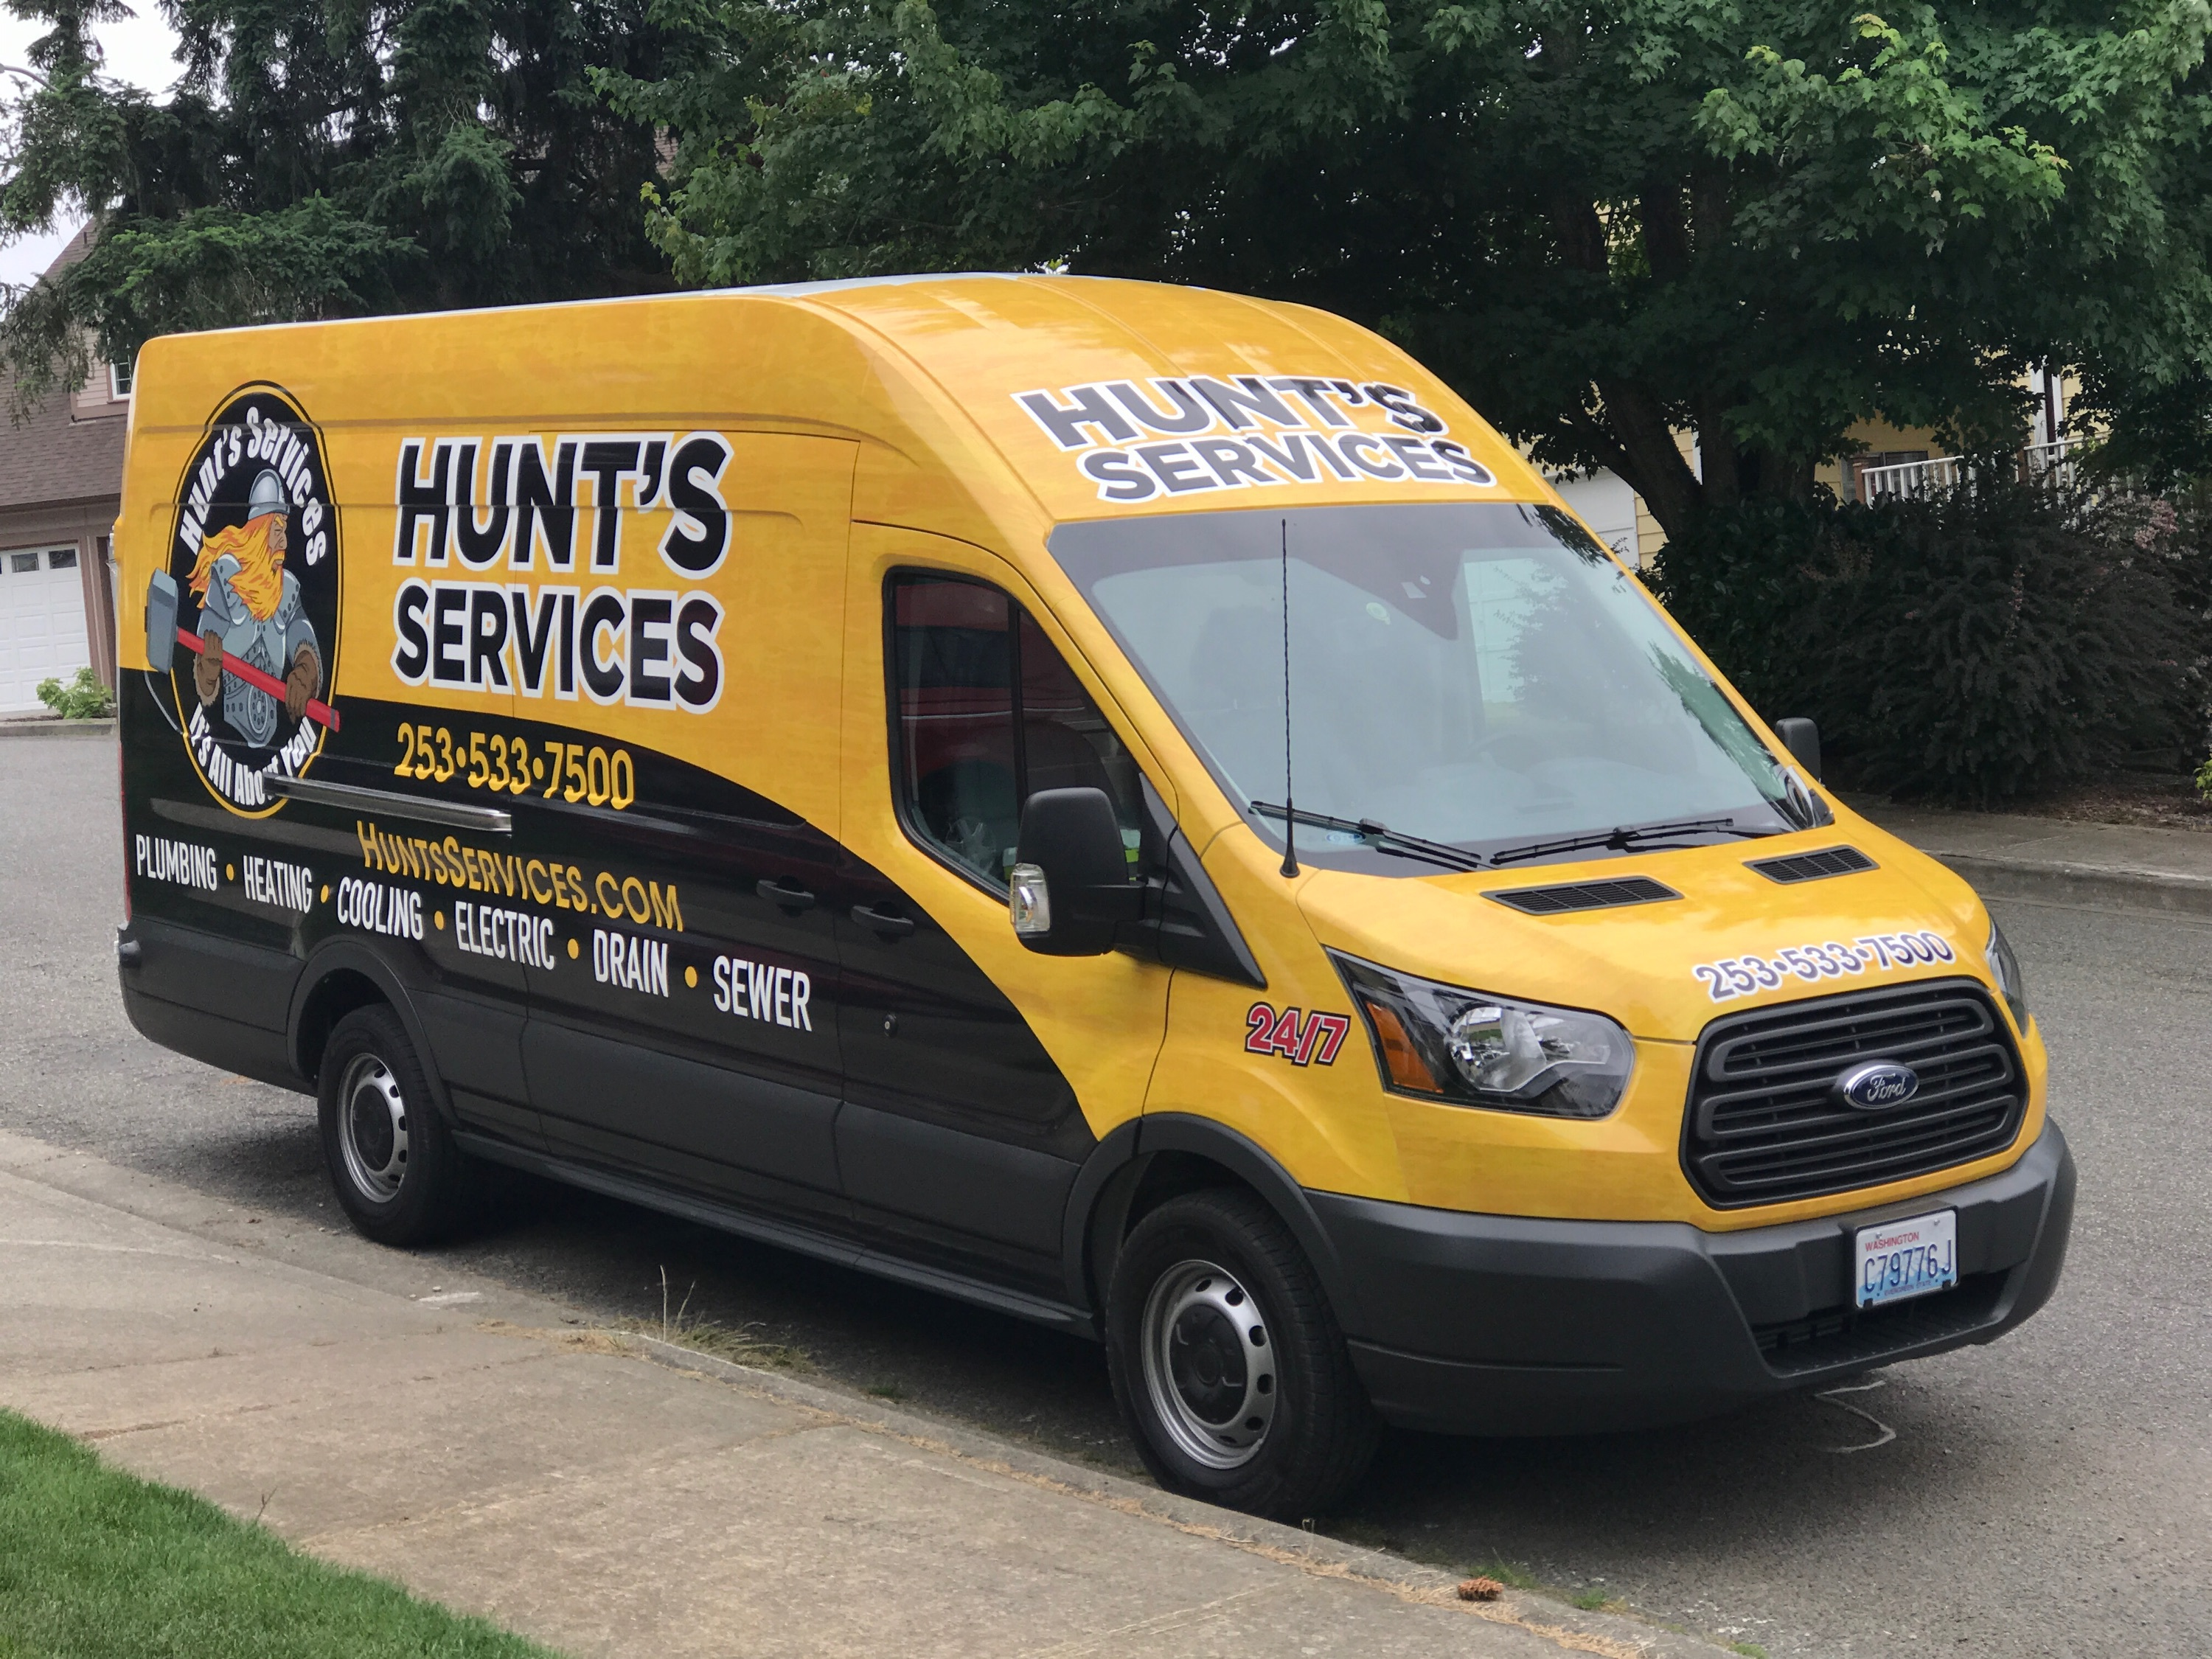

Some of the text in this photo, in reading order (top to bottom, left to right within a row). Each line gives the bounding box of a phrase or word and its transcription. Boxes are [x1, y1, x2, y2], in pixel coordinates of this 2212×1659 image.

[1011, 375, 1449, 452] HUNT'S
[180, 406, 327, 566] Hunt's Services
[392, 431, 735, 580] HUNT'S
[1075, 431, 1498, 503] SERVICES
[390, 577, 726, 714] SERVICES
[189, 701, 317, 806] It's All Abot You
[136, 834, 812, 1032] PLUMBING HEATING COOLING ELECTRIC DRAIN SEWER
[1245, 1001, 1352, 1067] 24/7
[1867, 1073, 1907, 1102] Ford
[1864, 1239, 1952, 1293] C79776J
[1865, 1232, 1920, 1252] WASHINGTON
